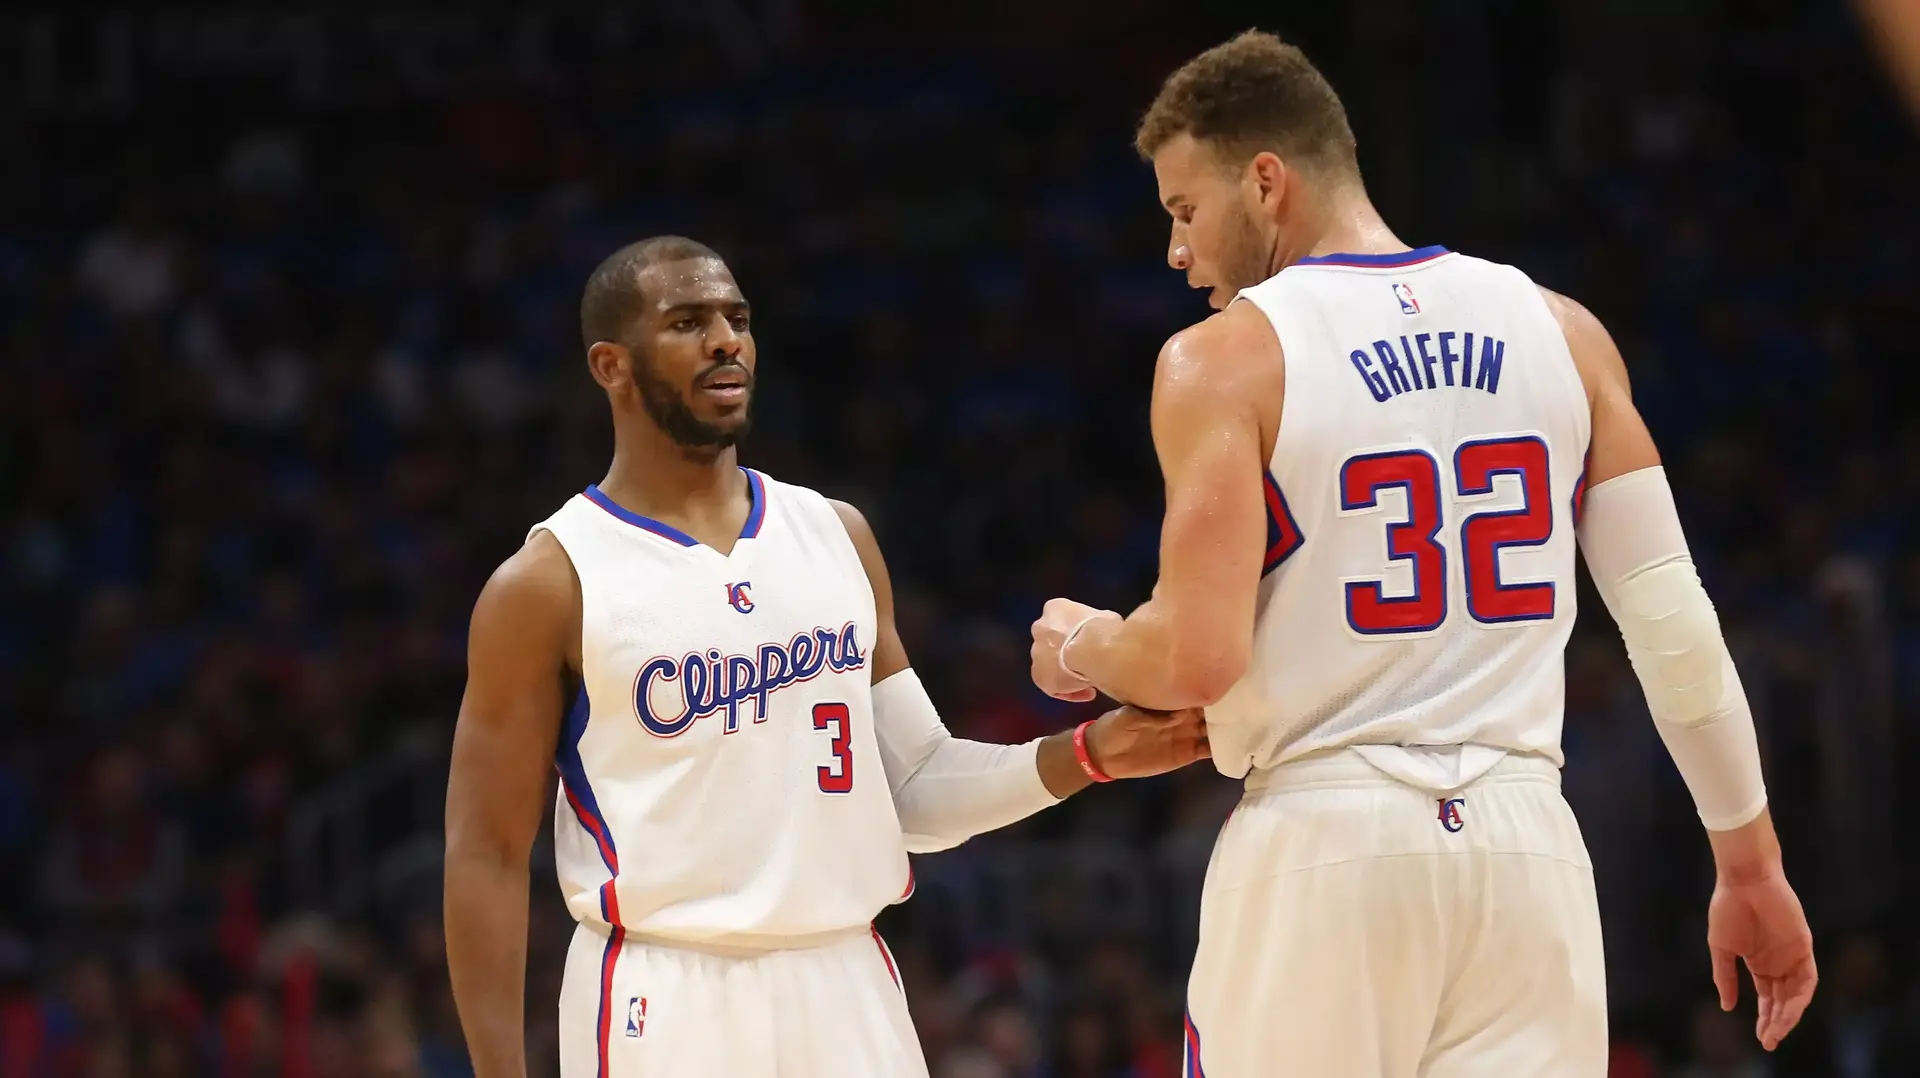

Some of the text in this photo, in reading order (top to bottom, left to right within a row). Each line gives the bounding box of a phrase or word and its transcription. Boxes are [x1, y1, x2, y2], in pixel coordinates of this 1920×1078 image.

[1350, 331, 1505, 402] GRIFFIN
[1338, 433, 1556, 637] 32
[632, 621, 866, 738] Clippers
[812, 702, 853, 794] 3
